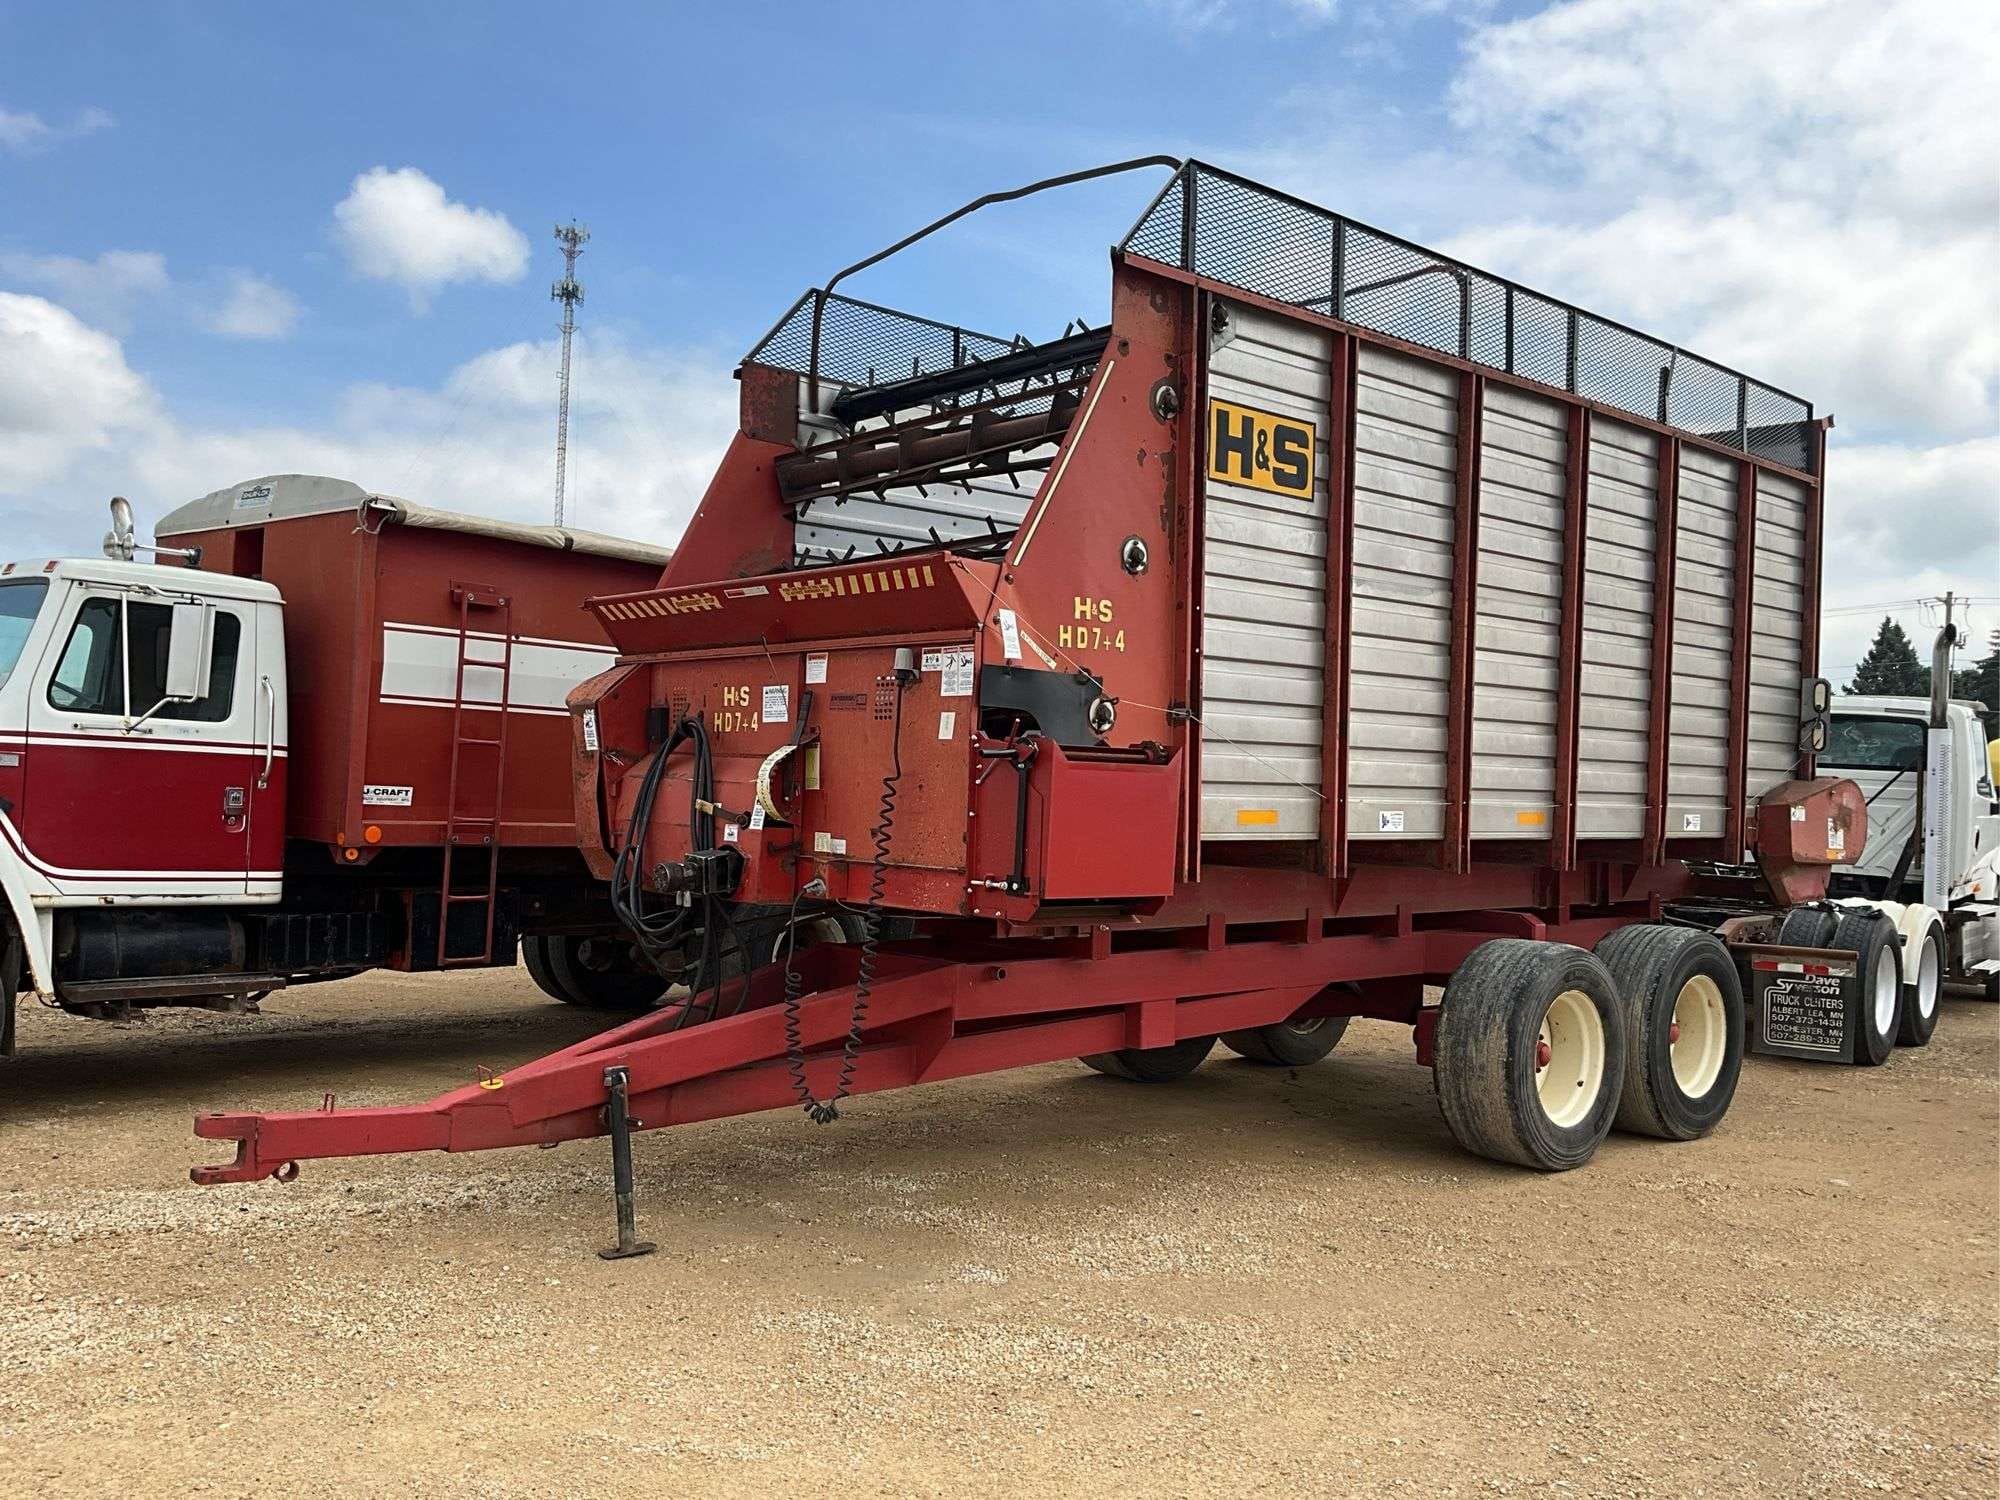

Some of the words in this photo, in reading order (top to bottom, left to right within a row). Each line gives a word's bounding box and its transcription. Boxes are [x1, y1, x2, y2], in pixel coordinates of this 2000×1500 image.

[1215, 408, 1309, 490] H&S
[1074, 597, 1113, 623] H&S
[1059, 624, 1125, 652] HD7+4
[724, 686, 750, 707] H&S
[714, 712, 758, 732] HD7+4
[1805, 974, 1840, 986] Dave
[1772, 994, 1800, 1006] TRUCK
[1771, 1014, 1843, 1027] 507-373-1438
[1772, 1006, 1804, 1016] ALBERT
